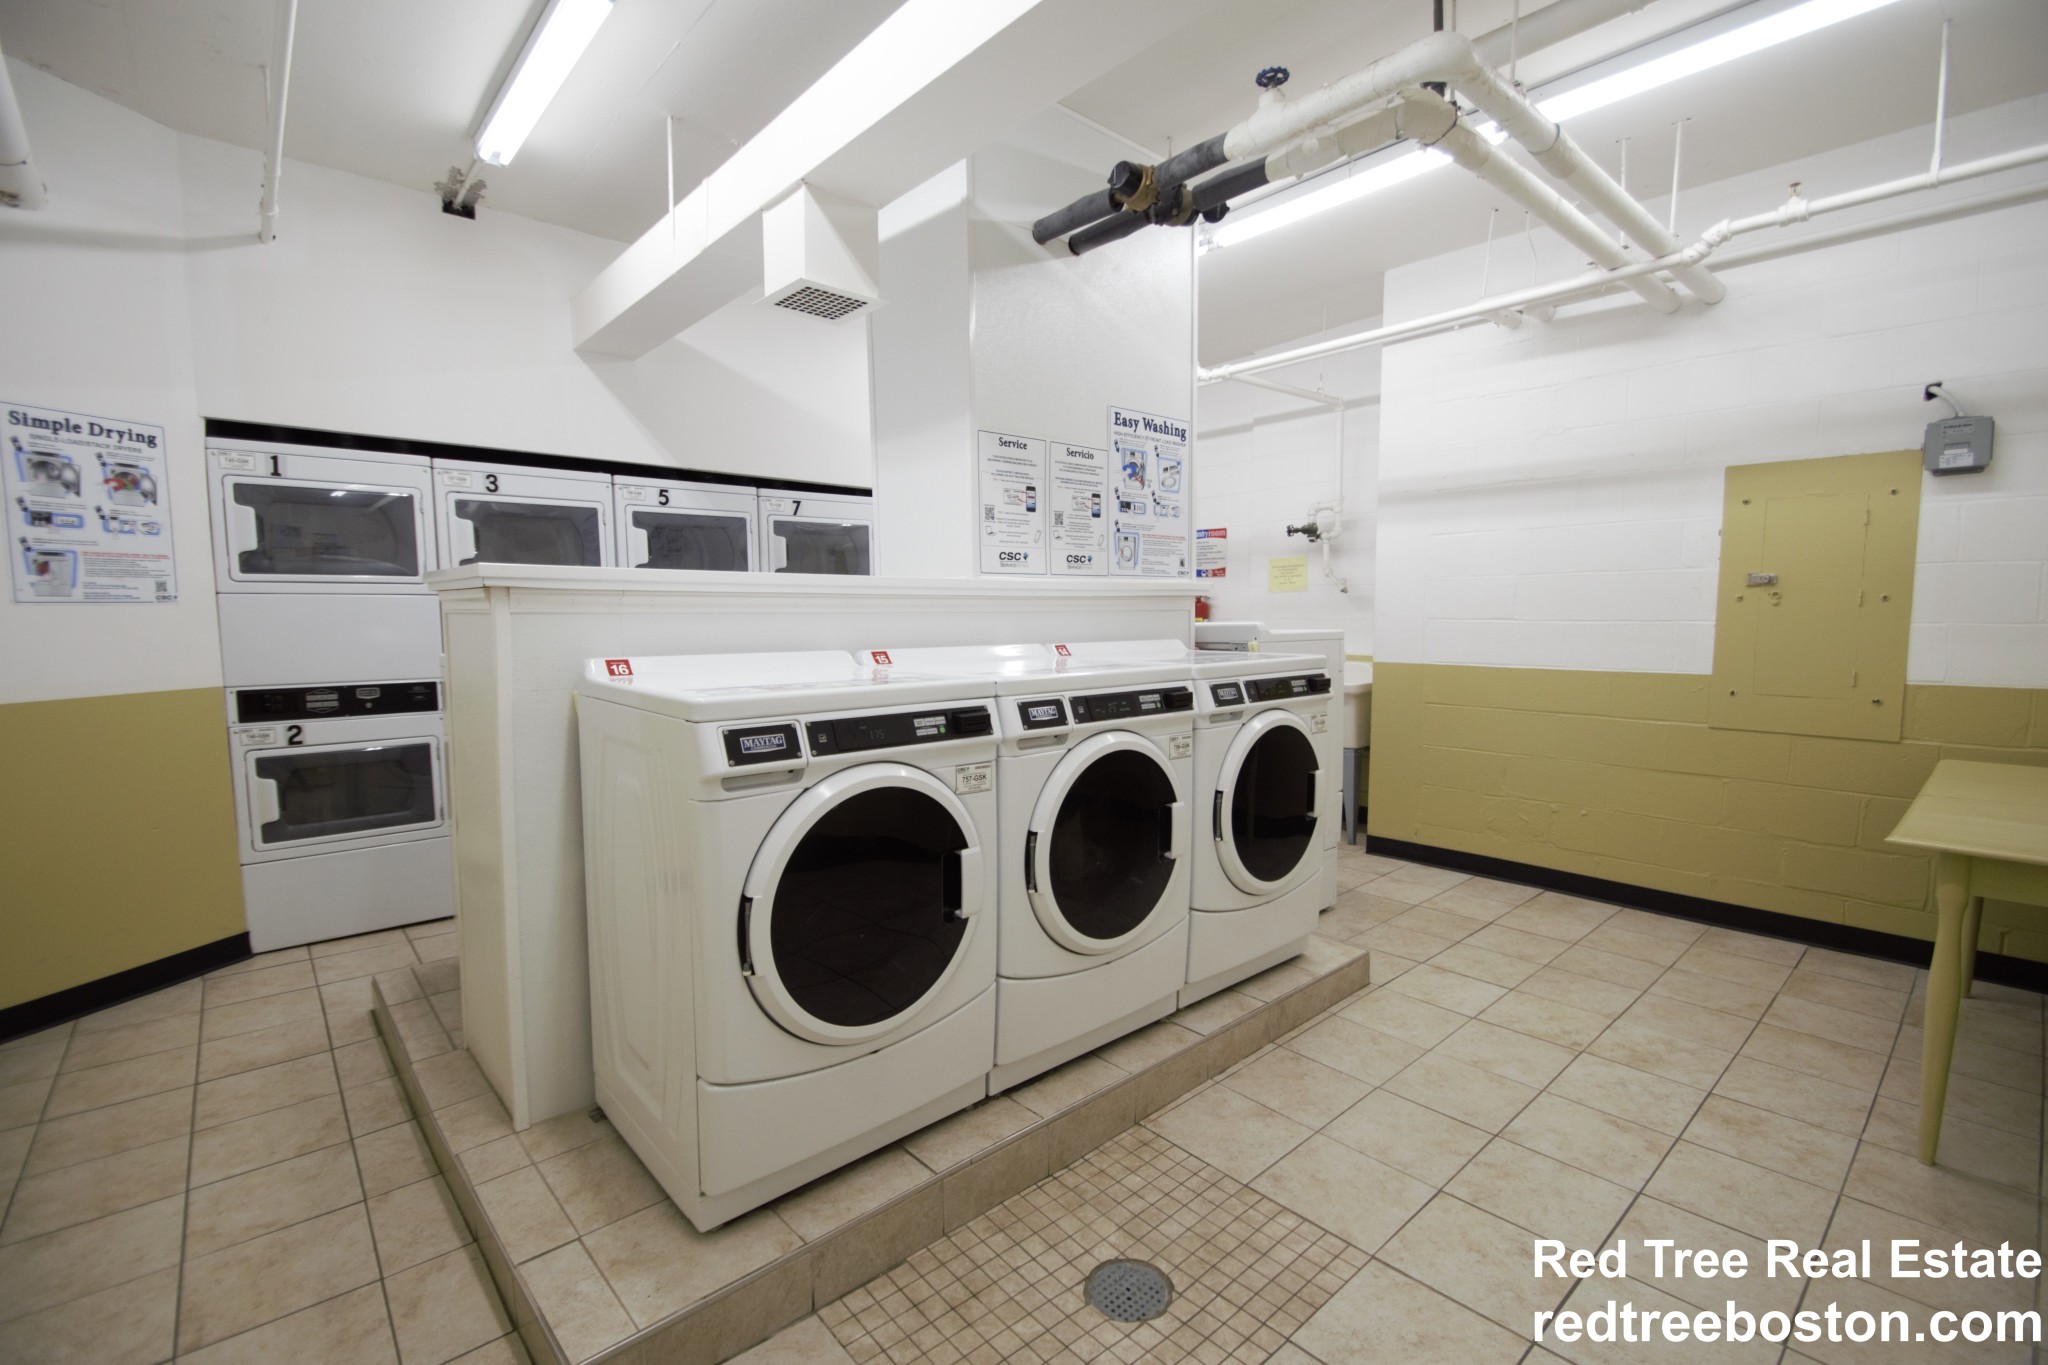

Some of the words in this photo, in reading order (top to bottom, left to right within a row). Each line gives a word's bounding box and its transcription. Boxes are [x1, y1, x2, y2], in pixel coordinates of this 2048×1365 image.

[8, 410, 82, 435] Simple
[88, 422, 158, 448] Drying
[1114, 411, 1139, 433] Easy
[1142, 417, 1187, 442] Washing
[998, 436, 1028, 450] Service
[1066, 447, 1094, 460] Servicio
[270, 454, 282, 477] 1
[485, 473, 499, 493] 3
[658, 489, 670, 506] 5
[792, 500, 802, 516] 7
[999, 551, 1022, 561] CSC
[1066, 554, 1087, 564] CSC
[875, 655, 889, 664] 15
[610, 664, 630, 675] 16
[1030, 708, 1056, 717] MAYTAG
[287, 725, 303, 745] 2
[743, 736, 783, 748] MAYTAG
[962, 774, 987, 783] 757-GSK
